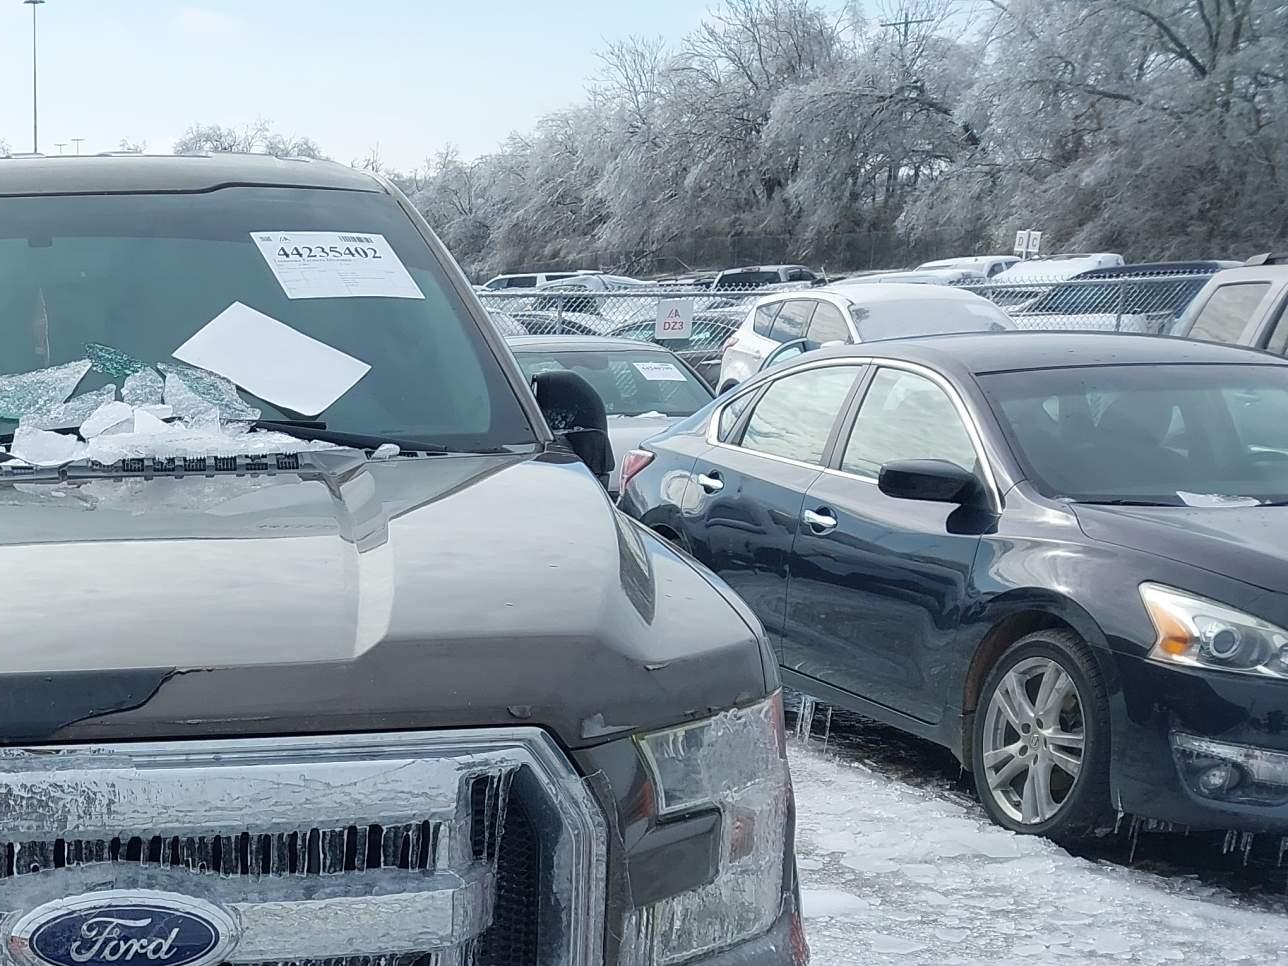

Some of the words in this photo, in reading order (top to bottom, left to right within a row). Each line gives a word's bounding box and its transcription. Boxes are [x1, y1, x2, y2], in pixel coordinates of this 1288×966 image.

[277, 246, 382, 259] 44235402
[663, 321, 684, 331] DZ3
[70, 917, 180, 962] Ford
